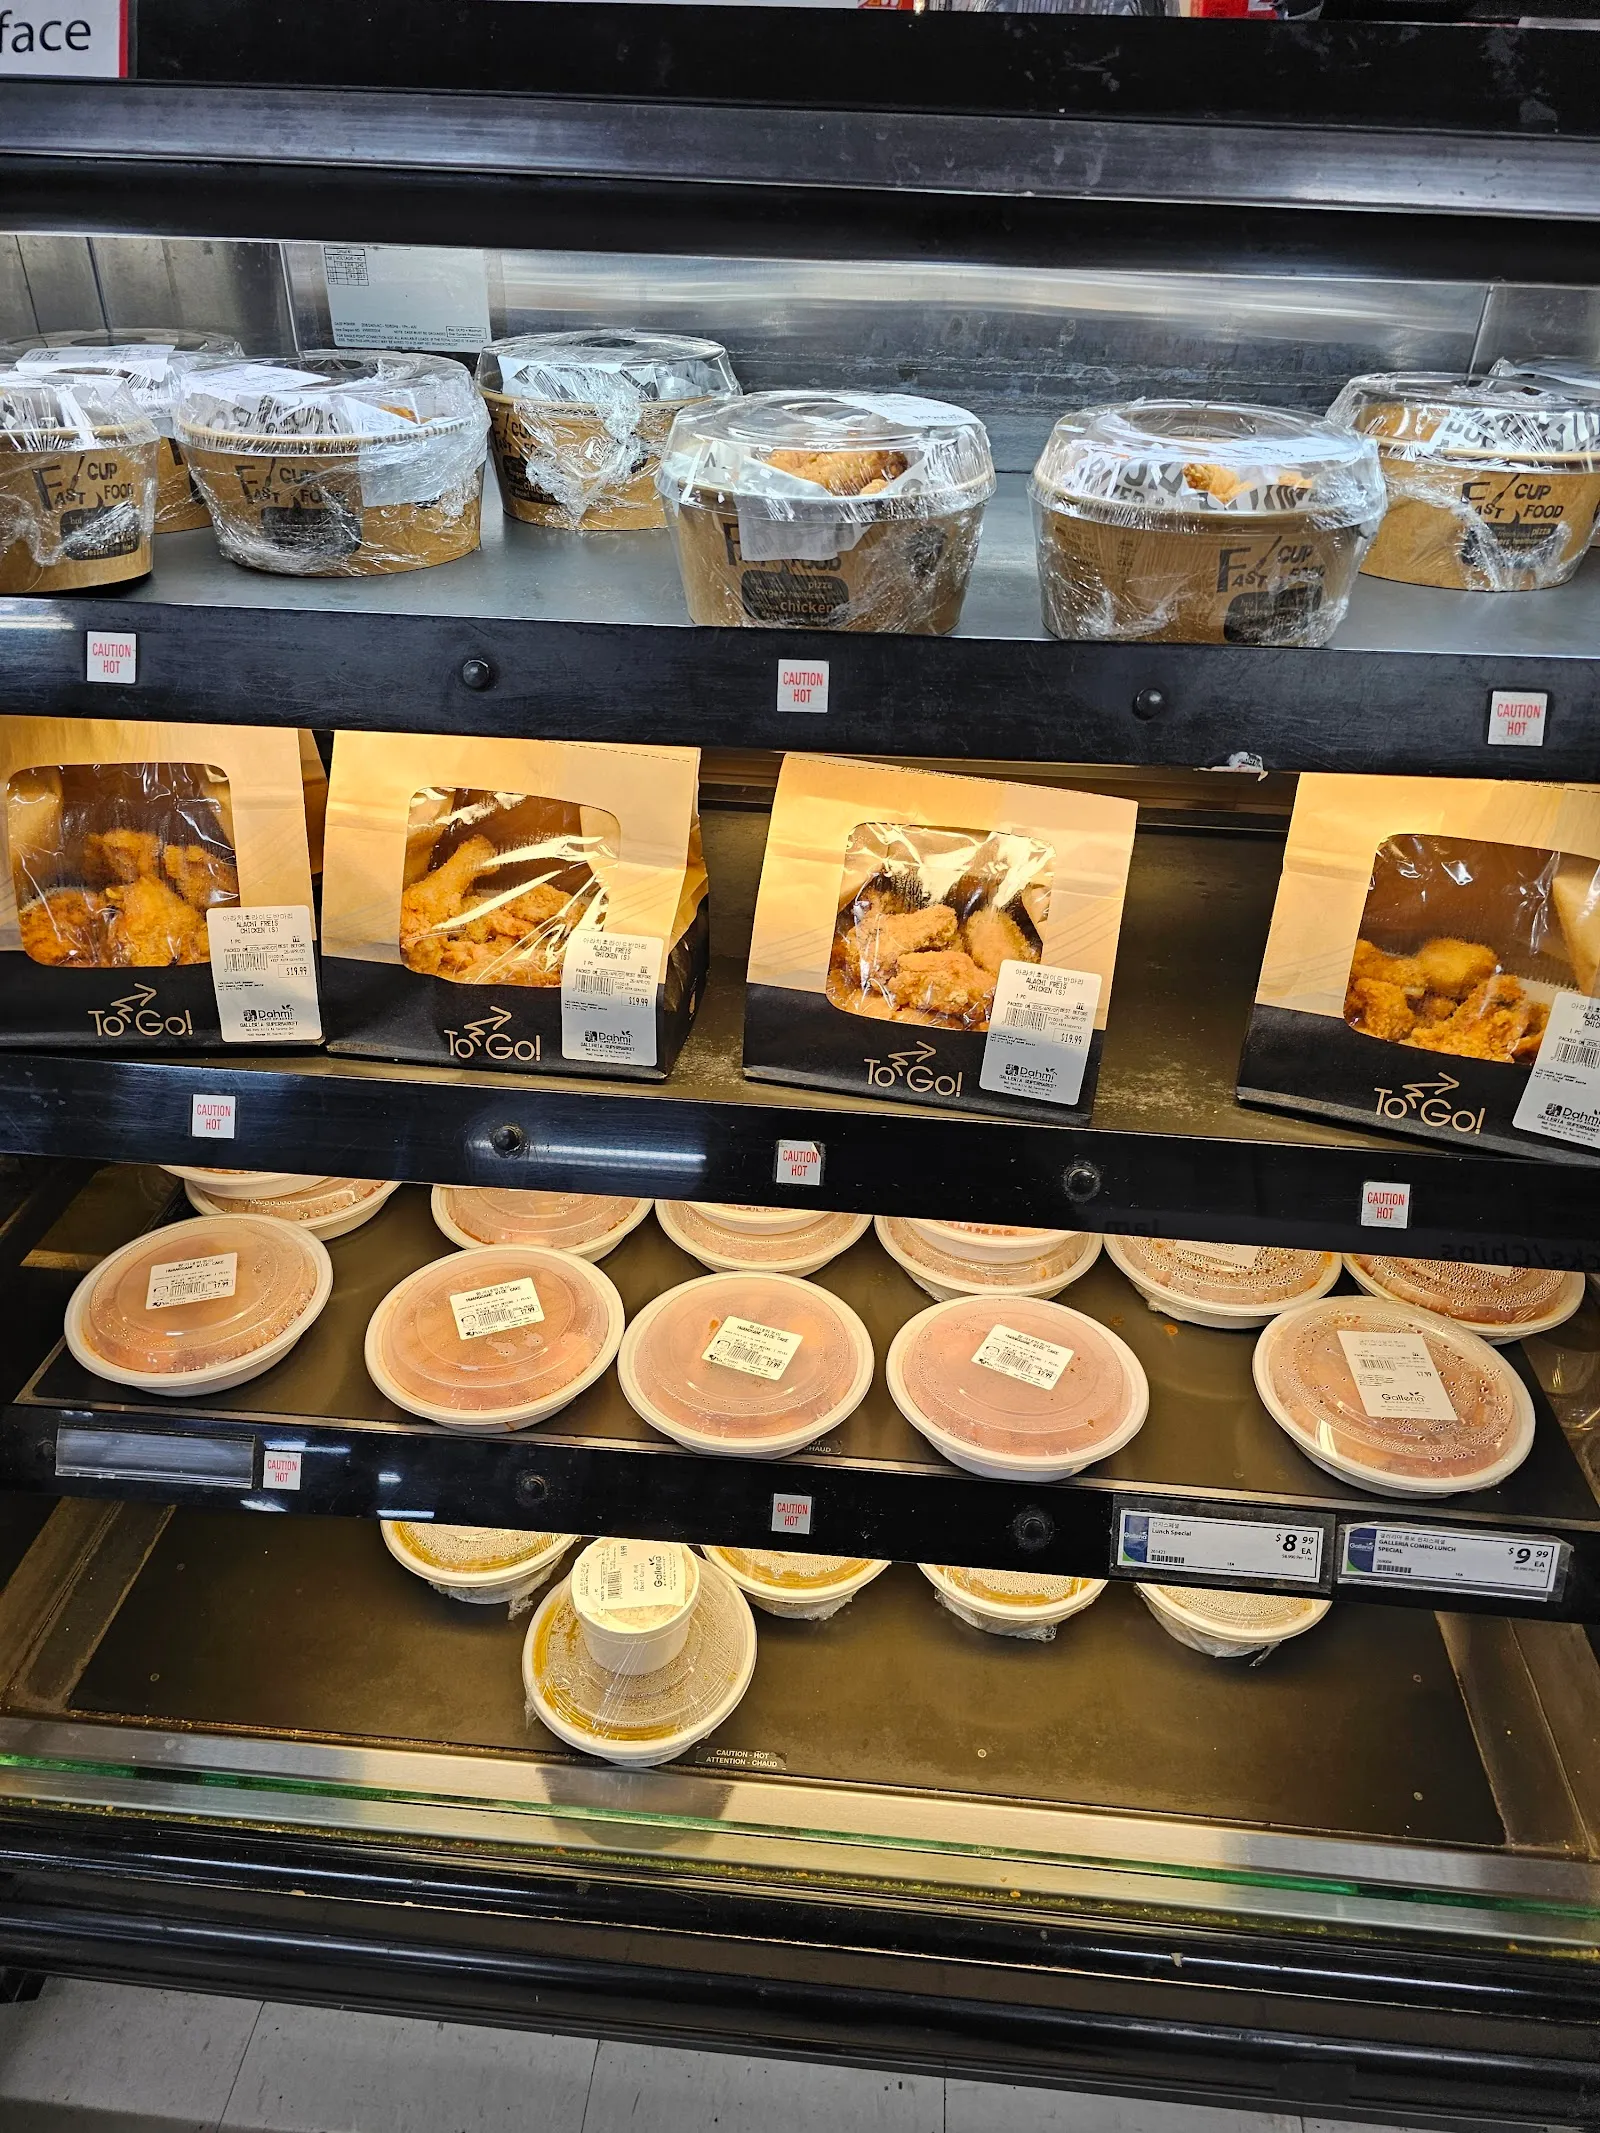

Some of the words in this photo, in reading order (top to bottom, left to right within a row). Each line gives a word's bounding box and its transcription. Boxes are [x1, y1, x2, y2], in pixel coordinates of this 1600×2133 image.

[0, 9, 91, 53] face
[1514, 483, 1552, 501] CUP
[1523, 504, 1564, 519] FOOD
[92, 642, 131, 658] CAUTION
[103, 660, 121, 674] HOT
[783, 671, 823, 686] CAUTION
[793, 688, 812, 703] HOT
[1497, 703, 1541, 719] CAUTION
[1507, 721, 1528, 736] HOT
[285, 966, 307, 976] $19.99
[1054, 988, 1065, 996] (S)
[628, 995, 648, 1006] $19.99
[257, 1008, 293, 1019] Dahmi
[88, 1010, 125, 1037] To
[135, 1009, 193, 1036] Go!
[597, 1031, 631, 1043] Dahmi
[1060, 1032, 1083, 1045] $19.99
[444, 1029, 479, 1059] To
[485, 1033, 540, 1061] Go!
[864, 1058, 896, 1088] To
[906, 1065, 963, 1098] Go!
[1019, 1066, 1054, 1080] Dahmi
[196, 1103, 231, 1117] CAUTION
[1374, 1087, 1408, 1119] To
[1420, 1098, 1486, 1135] Go!
[205, 1118, 222, 1131] HOT
[1537, 1114, 1564, 1125] GALLERIA
[783, 1149, 818, 1163] CAUTION
[791, 1165, 808, 1177] HOT
[1367, 1191, 1405, 1206] CAUTION
[1376, 1207, 1394, 1220] HOT
[1381, 1393, 1426, 1403] Galleria
[267, 1459, 298, 1471] CAUTION
[274, 1472, 289, 1483] HOT
[776, 1502, 809, 1515] CAUTION
[784, 1515, 799, 1526] HOT
[1151, 1528, 1170, 1536] Lunch
[1170, 1529, 1192, 1537] Special
[1275, 1533, 1282, 1543] $
[1282, 1534, 1298, 1552] 8
[1302, 1536, 1314, 1545] 99
[1349, 1542, 1375, 1551] Galleria
[1379, 1539, 1409, 1548] GALLERIA
[1434, 1545, 1457, 1553] LUNCH
[1301, 1547, 1312, 1555] EA
[1378, 1546, 1403, 1554] SPECIAL
[1508, 1547, 1514, 1556] $
[1514, 1547, 1532, 1565] 9
[1535, 1550, 1549, 1559] 99
[1534, 1560, 1545, 1568] EA
[653, 1555, 663, 1587] Galleria
[716, 1749, 748, 1758] CAUTION
[706, 1756, 746, 1765] ATTENTION
[751, 1760, 778, 1768] CHAUD
